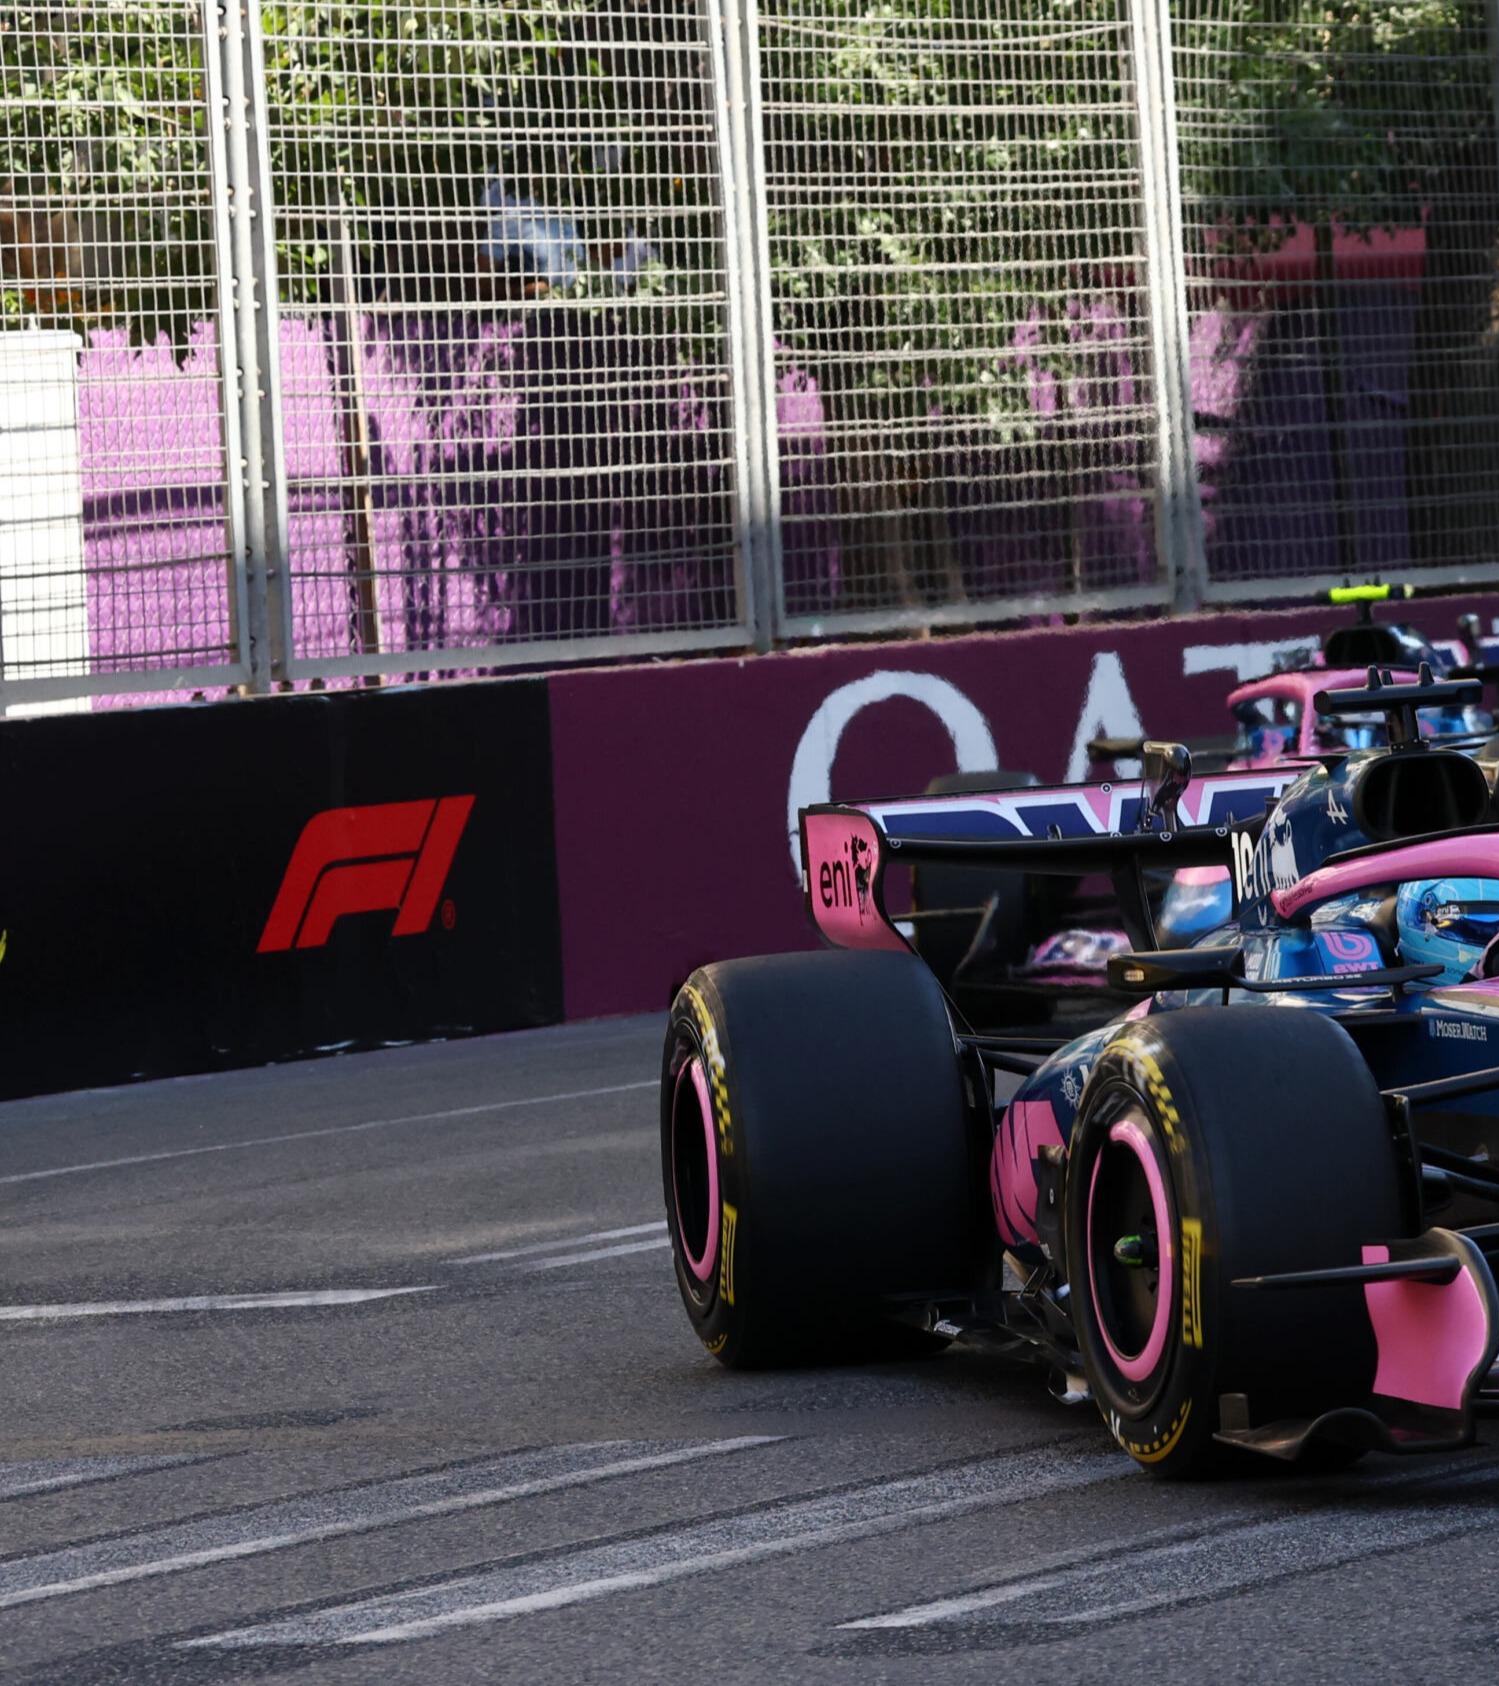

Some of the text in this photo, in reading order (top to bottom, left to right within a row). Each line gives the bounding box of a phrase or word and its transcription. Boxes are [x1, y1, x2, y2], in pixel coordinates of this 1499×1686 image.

[256, 794, 477, 954] F1
[819, 841, 853, 909] eni
[1332, 961, 1379, 975] BWT
